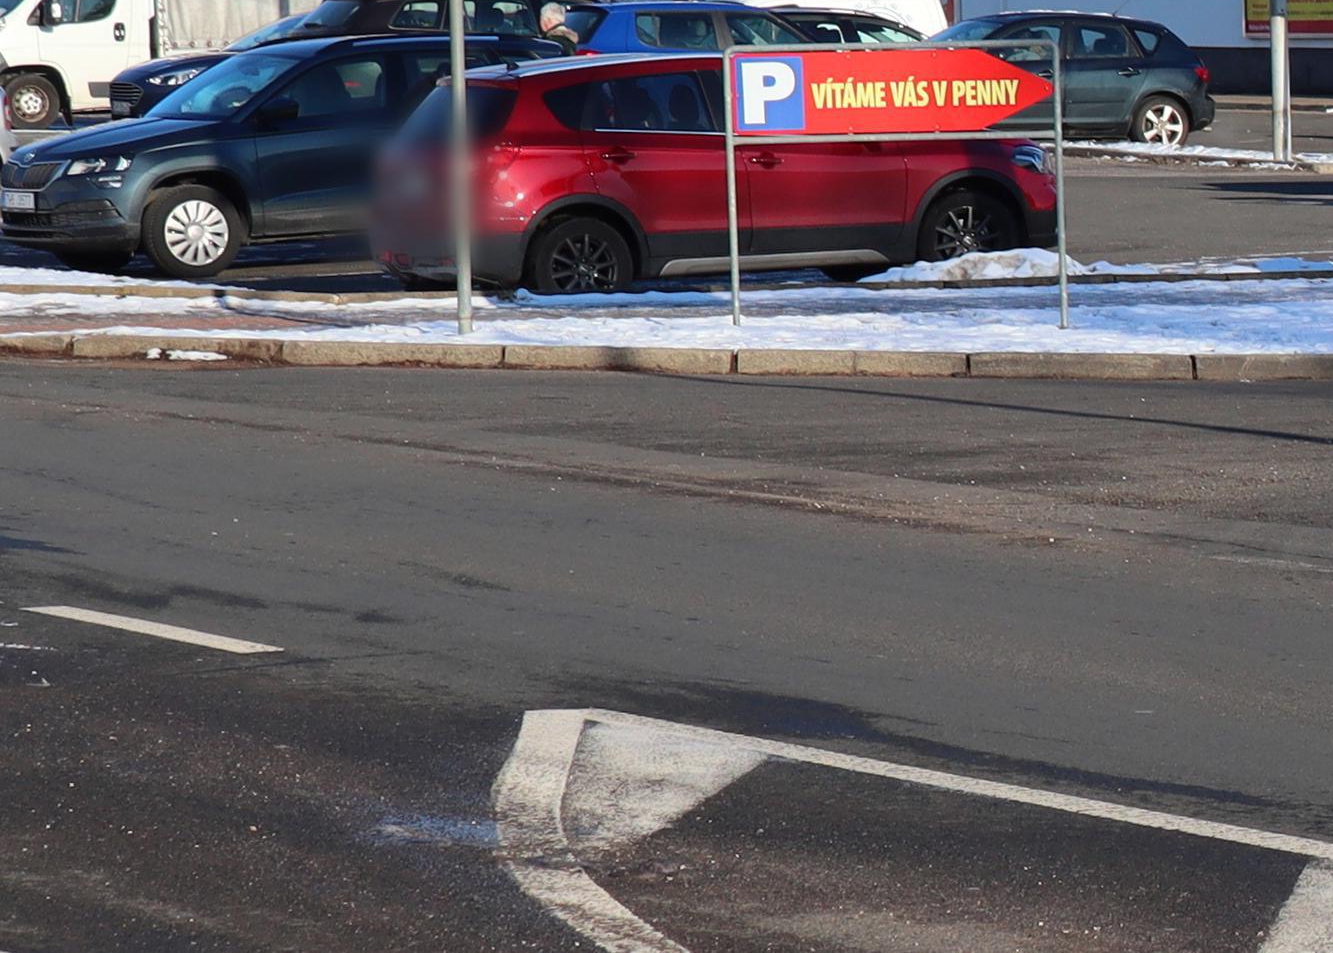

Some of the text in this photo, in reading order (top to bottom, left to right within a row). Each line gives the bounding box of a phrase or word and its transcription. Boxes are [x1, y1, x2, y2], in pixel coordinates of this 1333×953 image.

[741, 61, 795, 124] P
[811, 76, 1019, 109] VÍTÁME VÁS V PENNY
